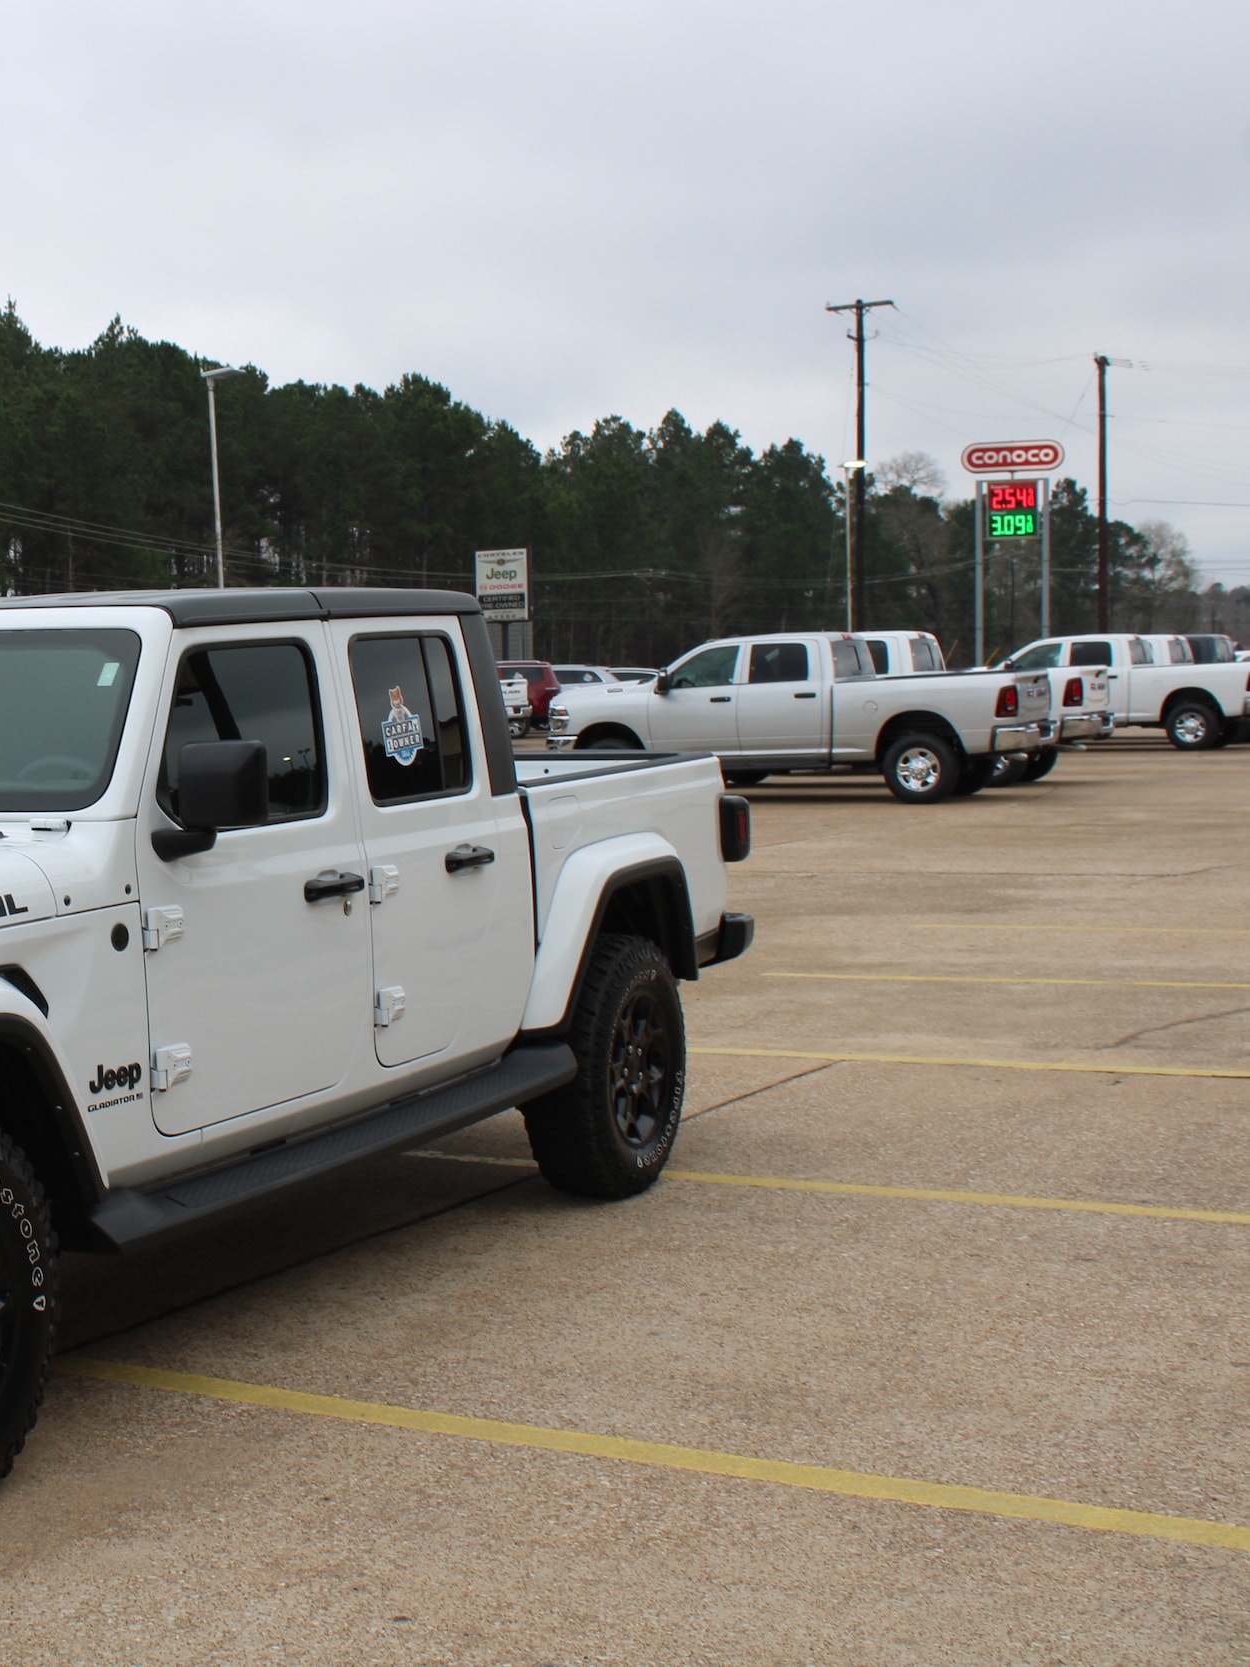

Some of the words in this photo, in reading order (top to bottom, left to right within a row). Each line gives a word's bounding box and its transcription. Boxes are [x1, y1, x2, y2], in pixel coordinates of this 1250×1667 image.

[486, 568, 517, 581] Jeep
[89, 1062, 142, 1094] Jeep
[87, 1094, 135, 1112] GLADIATOR
